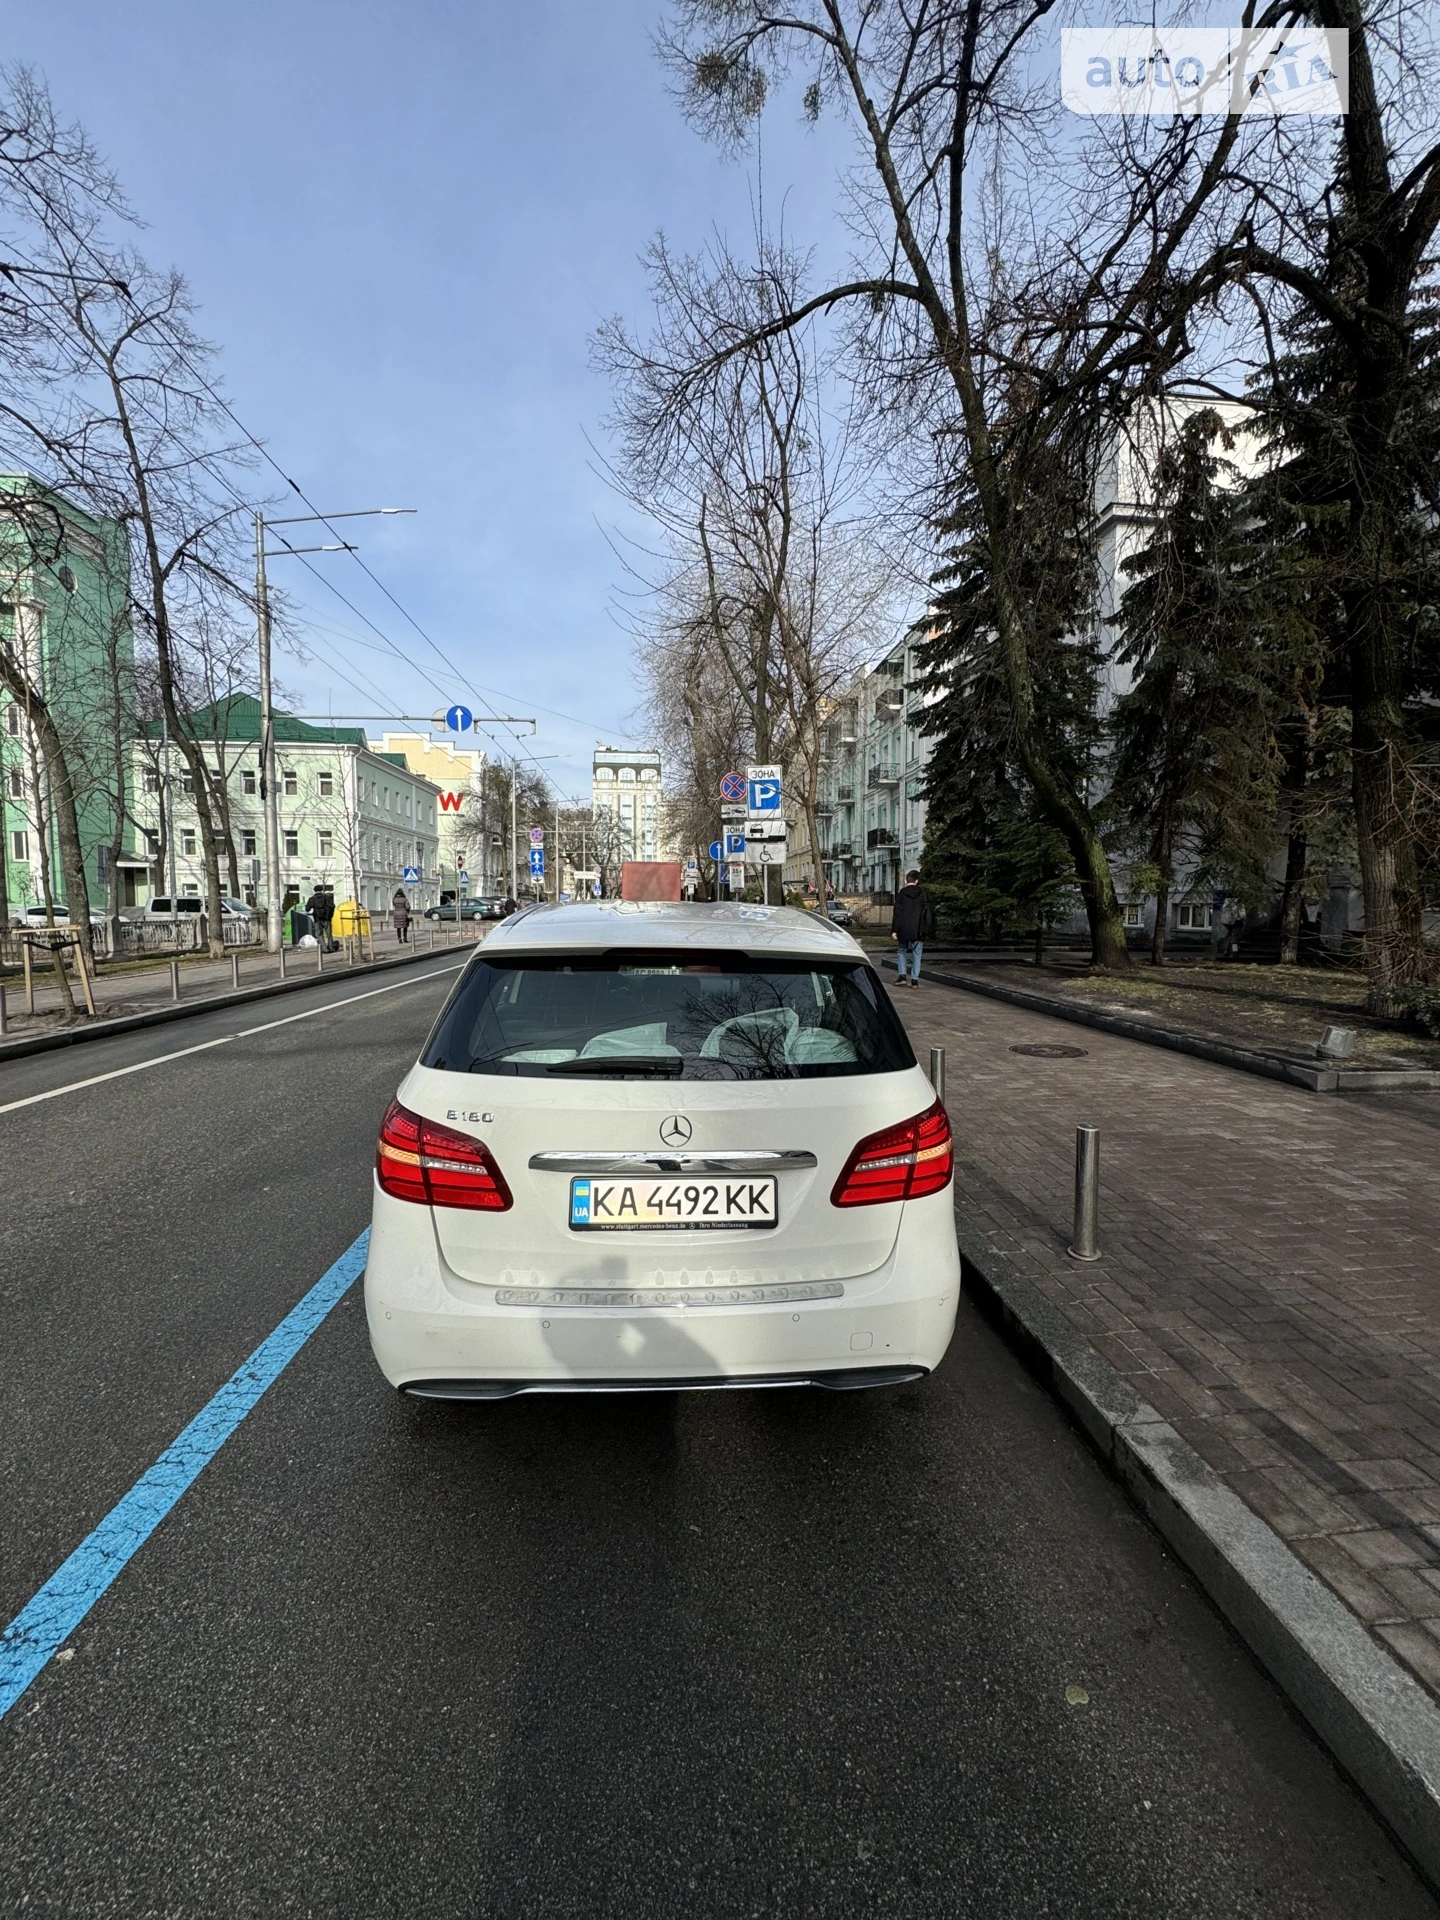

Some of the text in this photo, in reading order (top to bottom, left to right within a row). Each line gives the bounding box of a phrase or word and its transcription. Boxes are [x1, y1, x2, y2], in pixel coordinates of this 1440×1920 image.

[751, 770, 776, 779] ЗОНА
[438, 791, 464, 811] W
[754, 783, 777, 808] P
[731, 836, 742, 851] P
[593, 1184, 770, 1216] KA 4492 KK
[575, 1207, 588, 1217] UA
[600, 1222, 686, 1230] www.stuttgart.mercedes-benz.de
